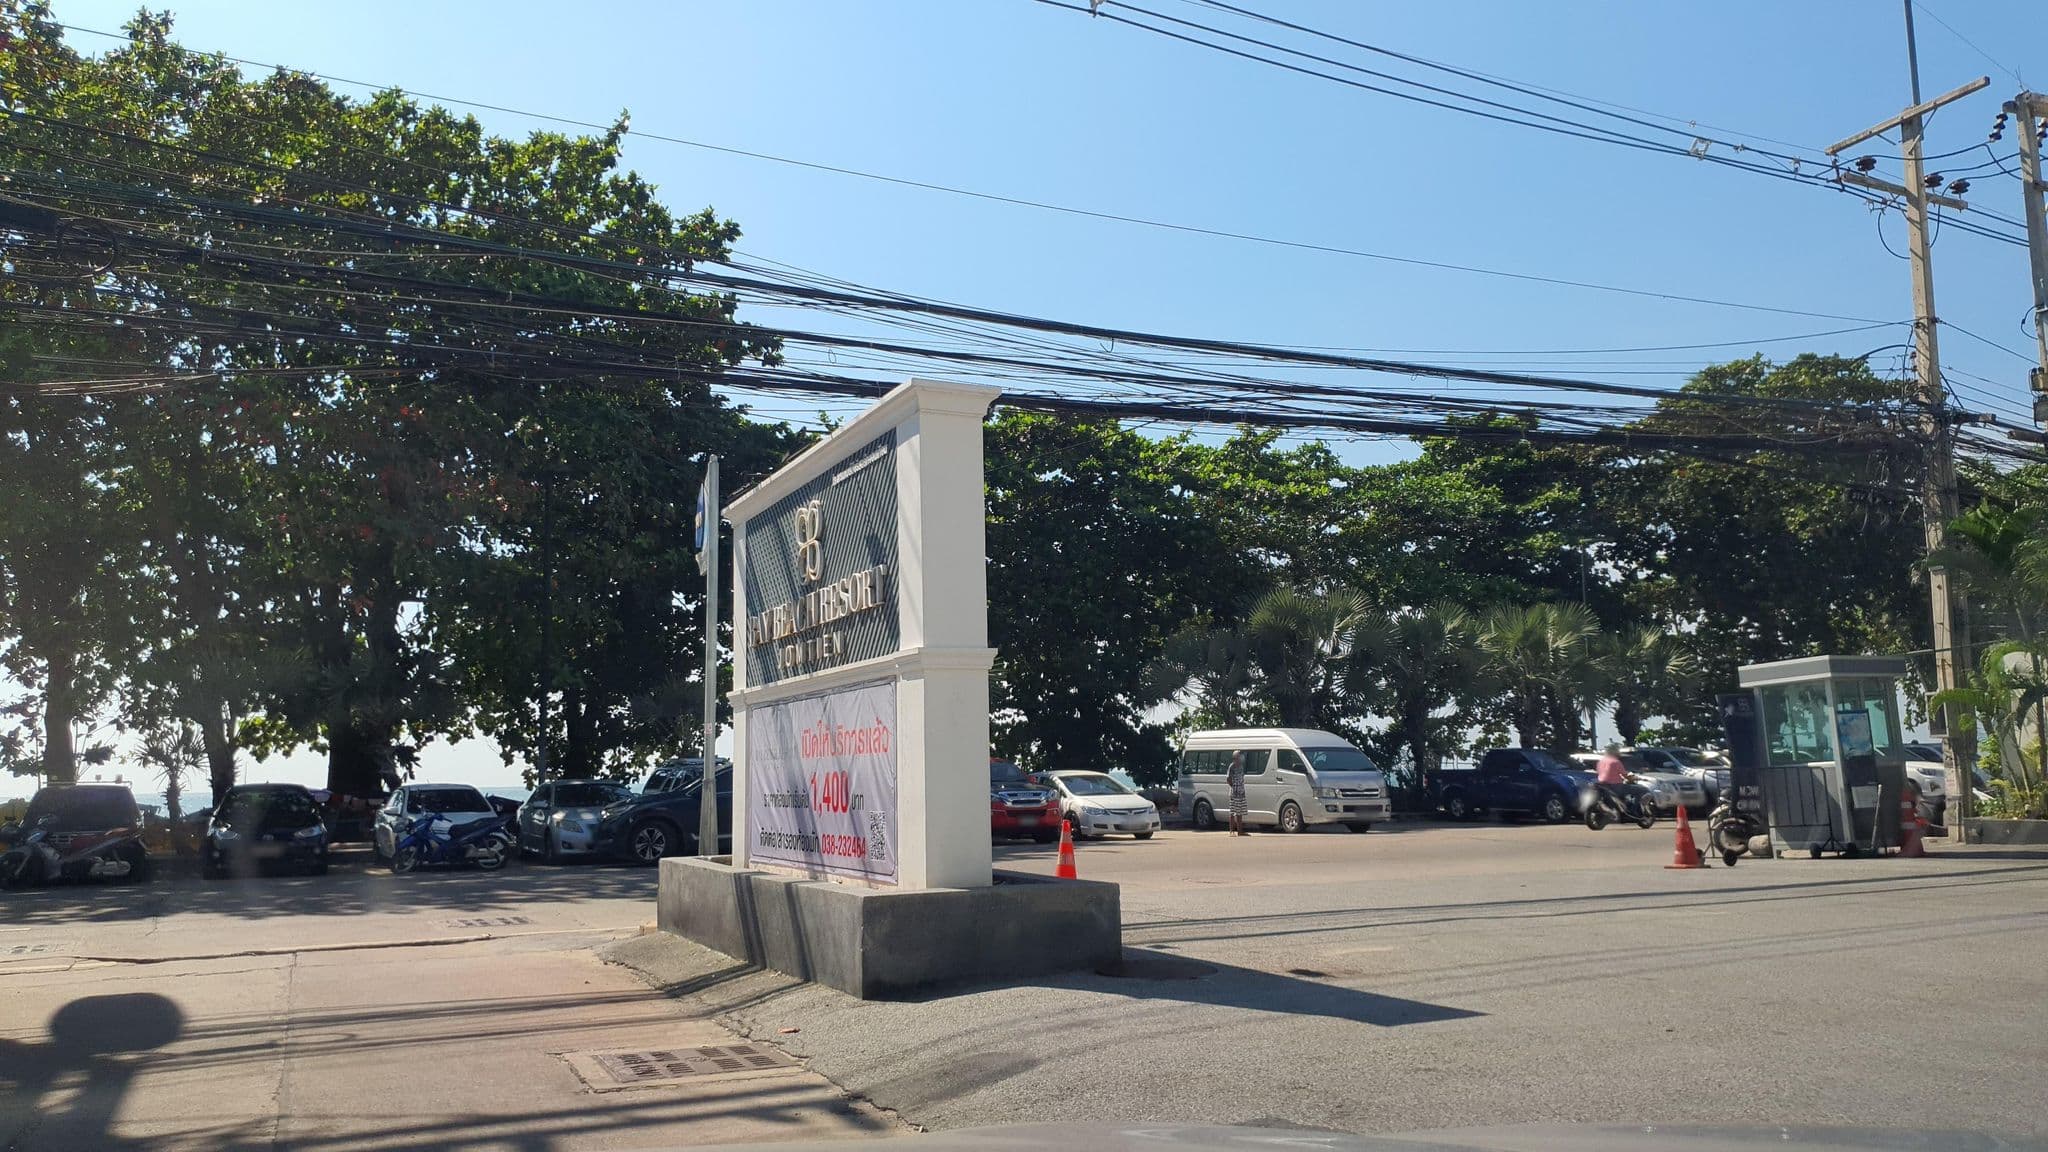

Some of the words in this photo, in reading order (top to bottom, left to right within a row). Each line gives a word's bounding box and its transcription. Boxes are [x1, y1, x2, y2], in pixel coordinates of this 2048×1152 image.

[749, 608, 774, 648] BAY
[773, 591, 819, 639] BEACH
[818, 564, 888, 624] RESORT
[801, 716, 892, 759] เปิดให้บริการแล้ว
[811, 771, 849, 816] 1,400
[851, 793, 865, 810] บาท
[821, 833, 867, 858] 038-232464
